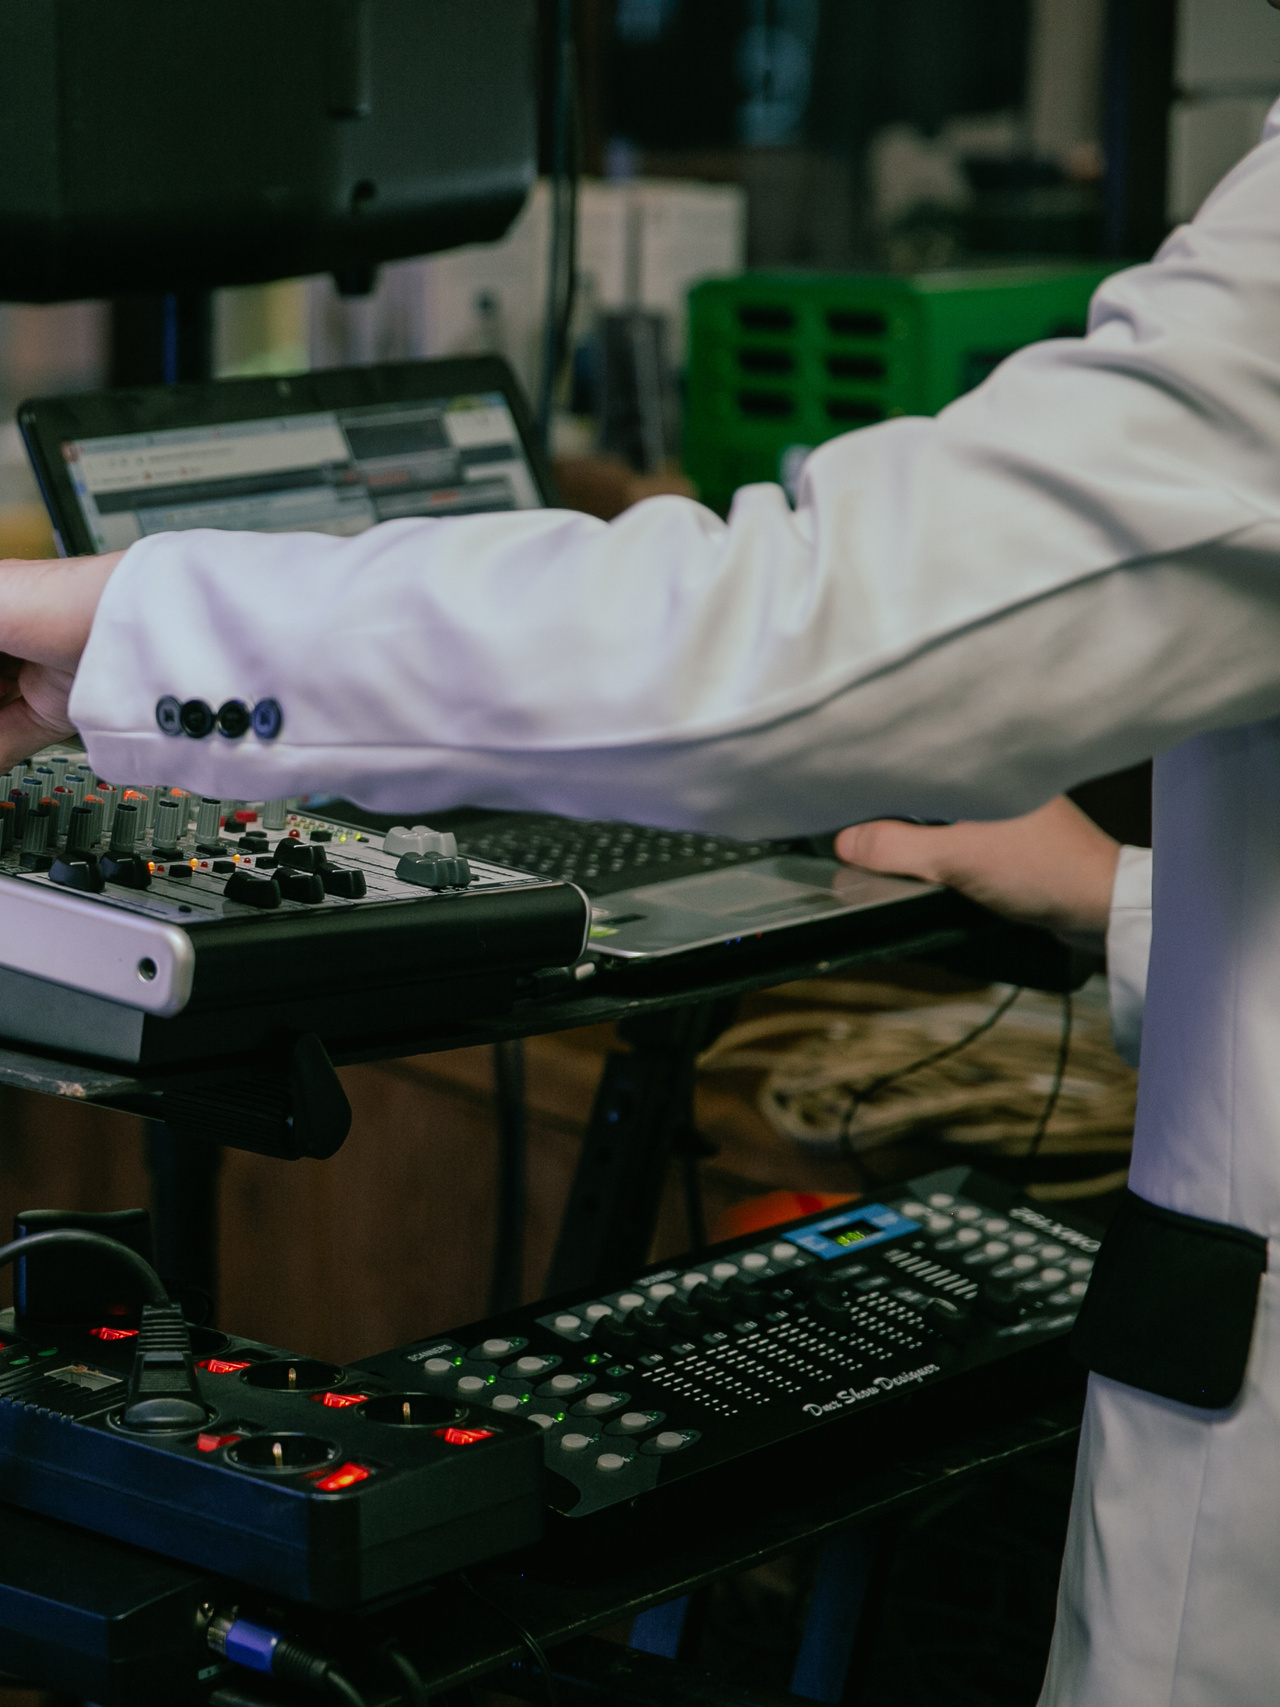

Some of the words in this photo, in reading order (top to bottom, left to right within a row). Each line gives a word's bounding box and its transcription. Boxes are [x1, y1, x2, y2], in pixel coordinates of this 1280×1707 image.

[802, 1400, 842, 1416] Dmx
[836, 1388, 880, 1404] Show
[872, 1364, 940, 1390] Designer
